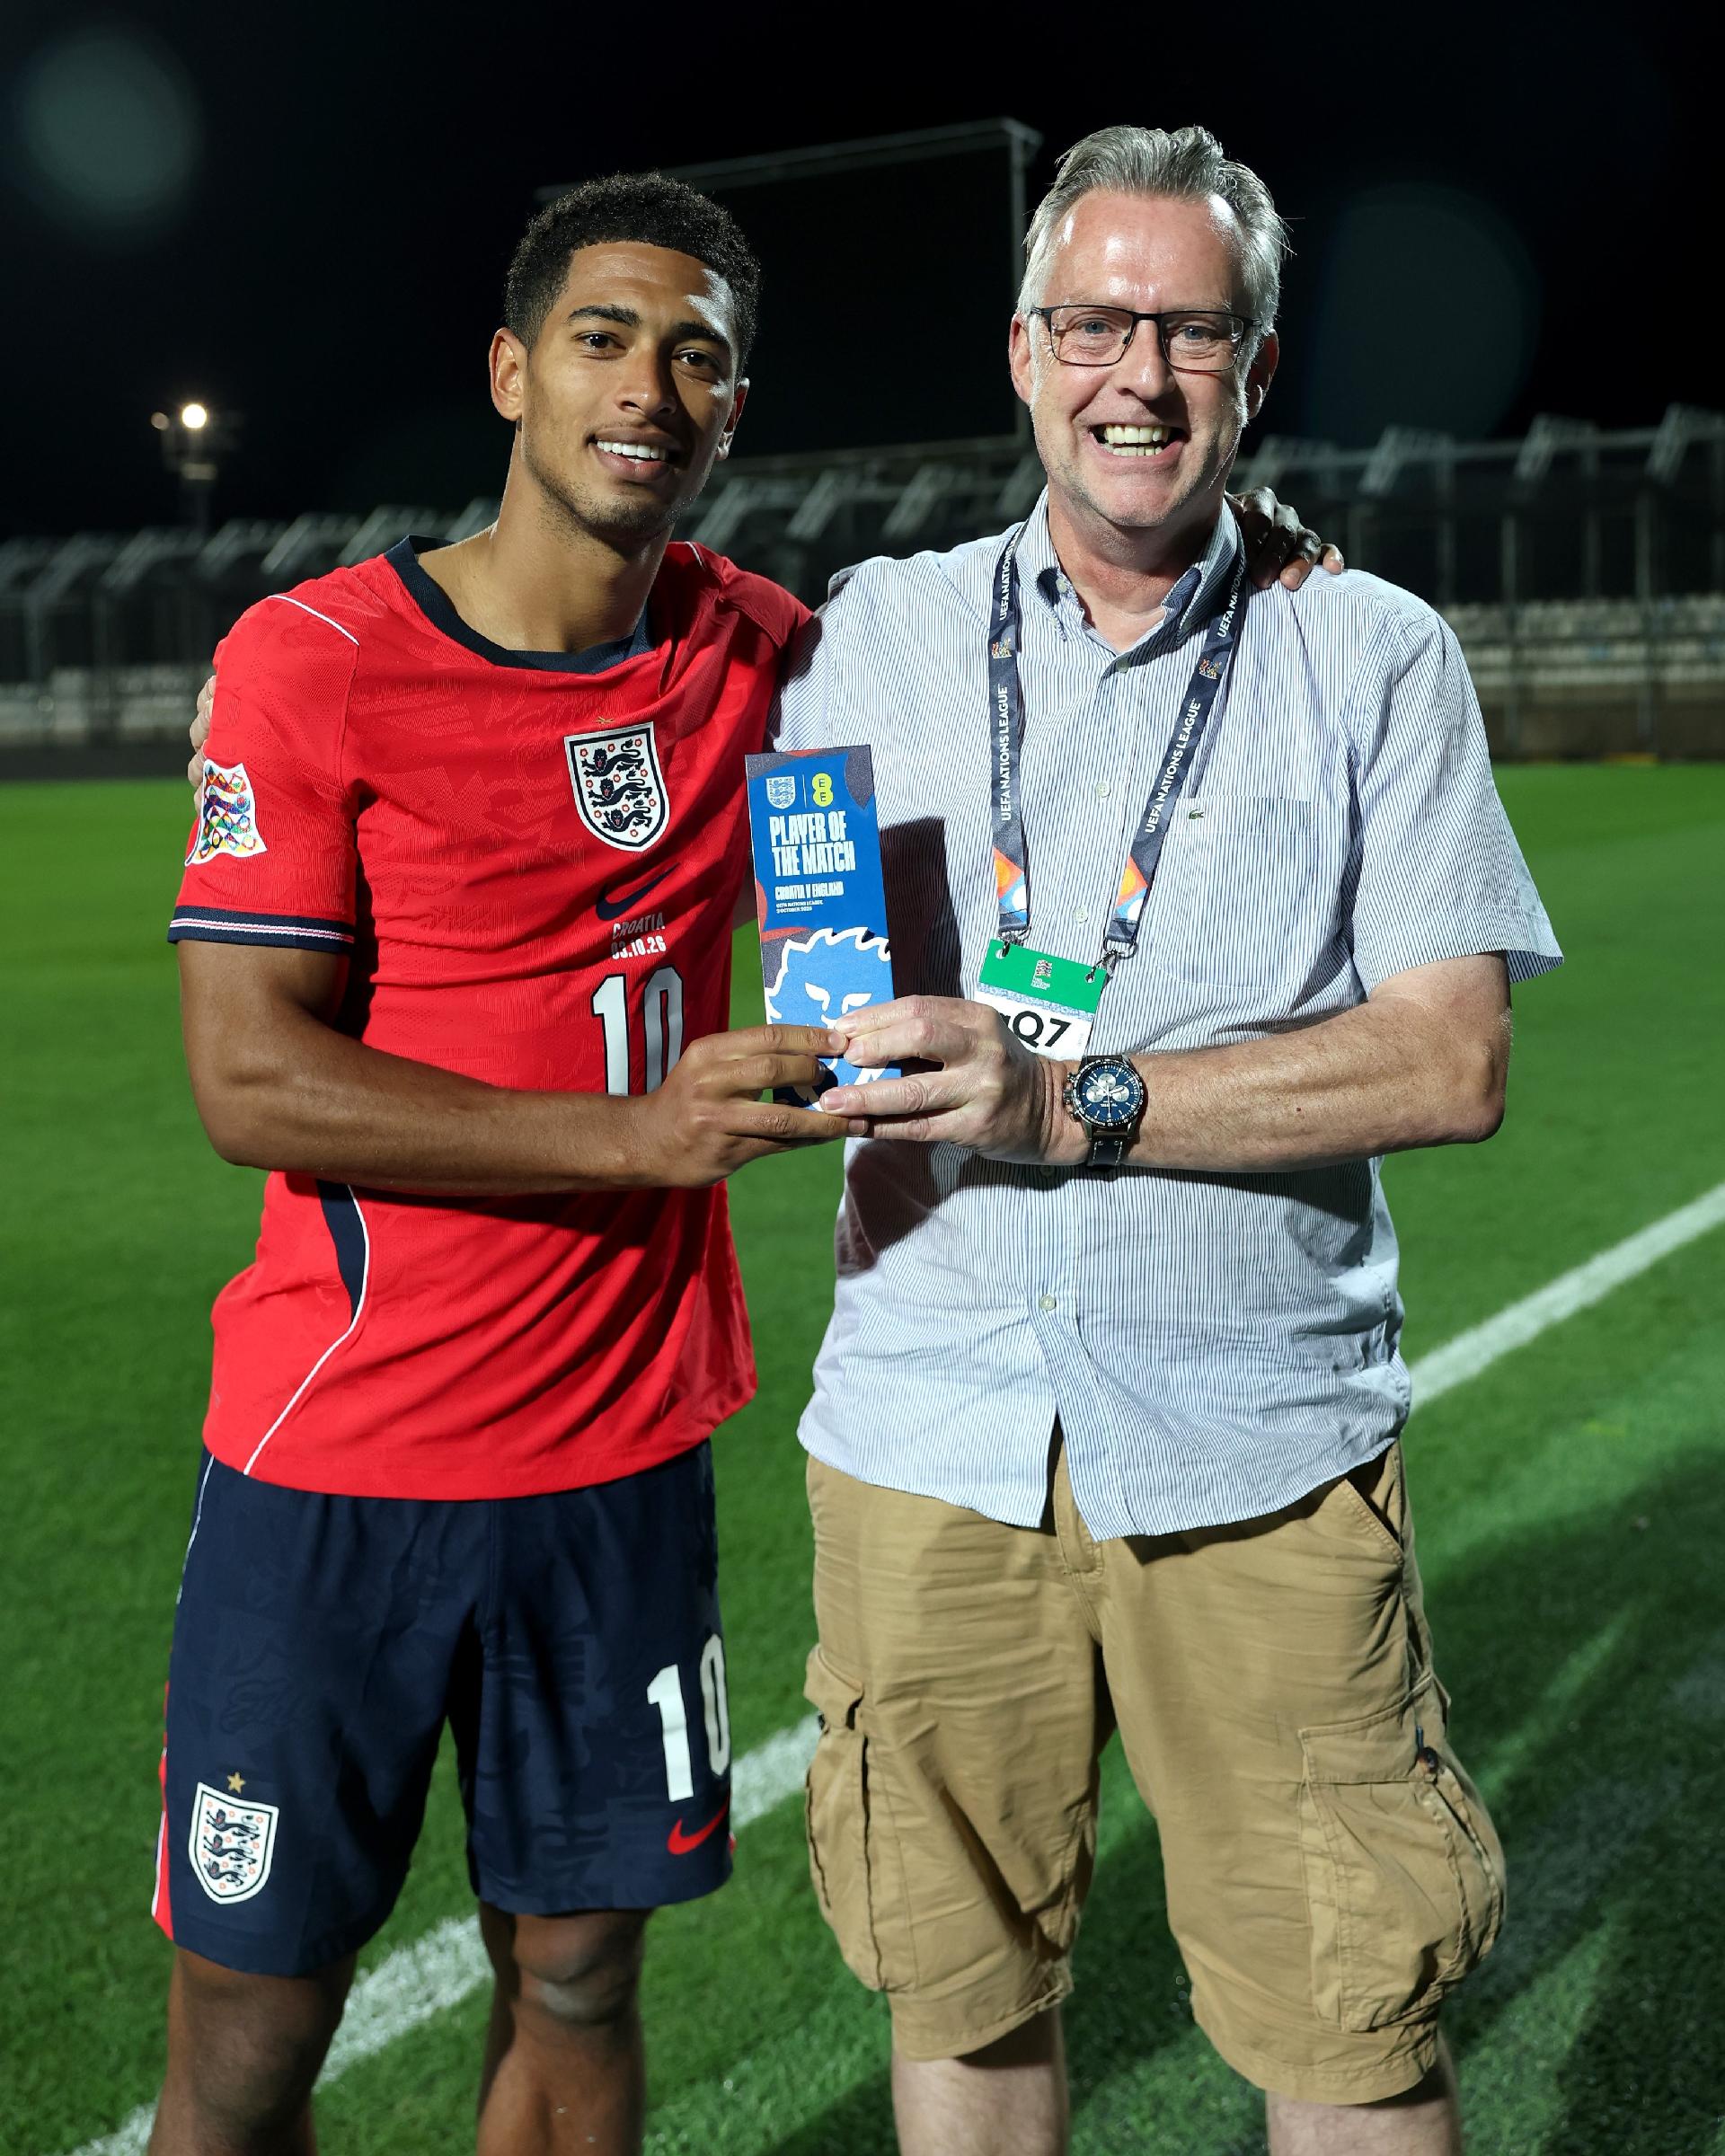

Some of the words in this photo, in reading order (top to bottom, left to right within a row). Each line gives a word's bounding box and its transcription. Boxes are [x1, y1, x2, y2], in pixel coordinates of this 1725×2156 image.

[1001, 547, 1014, 594] NATIONS
[999, 593, 1010, 621] UEFA
[1216, 610, 1234, 638] UEFA
[1229, 565, 1245, 610] NATIONS
[998, 686, 1009, 734] LEAGUE
[998, 734, 1011, 790] NATIONS
[1145, 800, 1164, 834] UEFA
[1157, 749, 1184, 802] NATIONS
[1176, 702, 1201, 749] LEAGUE
[1001, 791, 1012, 821] UEFA
[769, 812, 827, 846] PLAYER
[828, 810, 846, 841] OF
[772, 845, 800, 877] THE
[801, 841, 855, 874] MATCH
[775, 884, 806, 901] CROATIA
[811, 880, 844, 898] ENGLAND
[613, 912, 665, 940] CROATIA
[611, 935, 667, 959] 03.10.26
[591, 966, 684, 1097] 10
[999, 1011, 1072, 1048] Q7
[646, 1633, 730, 1802] 10
